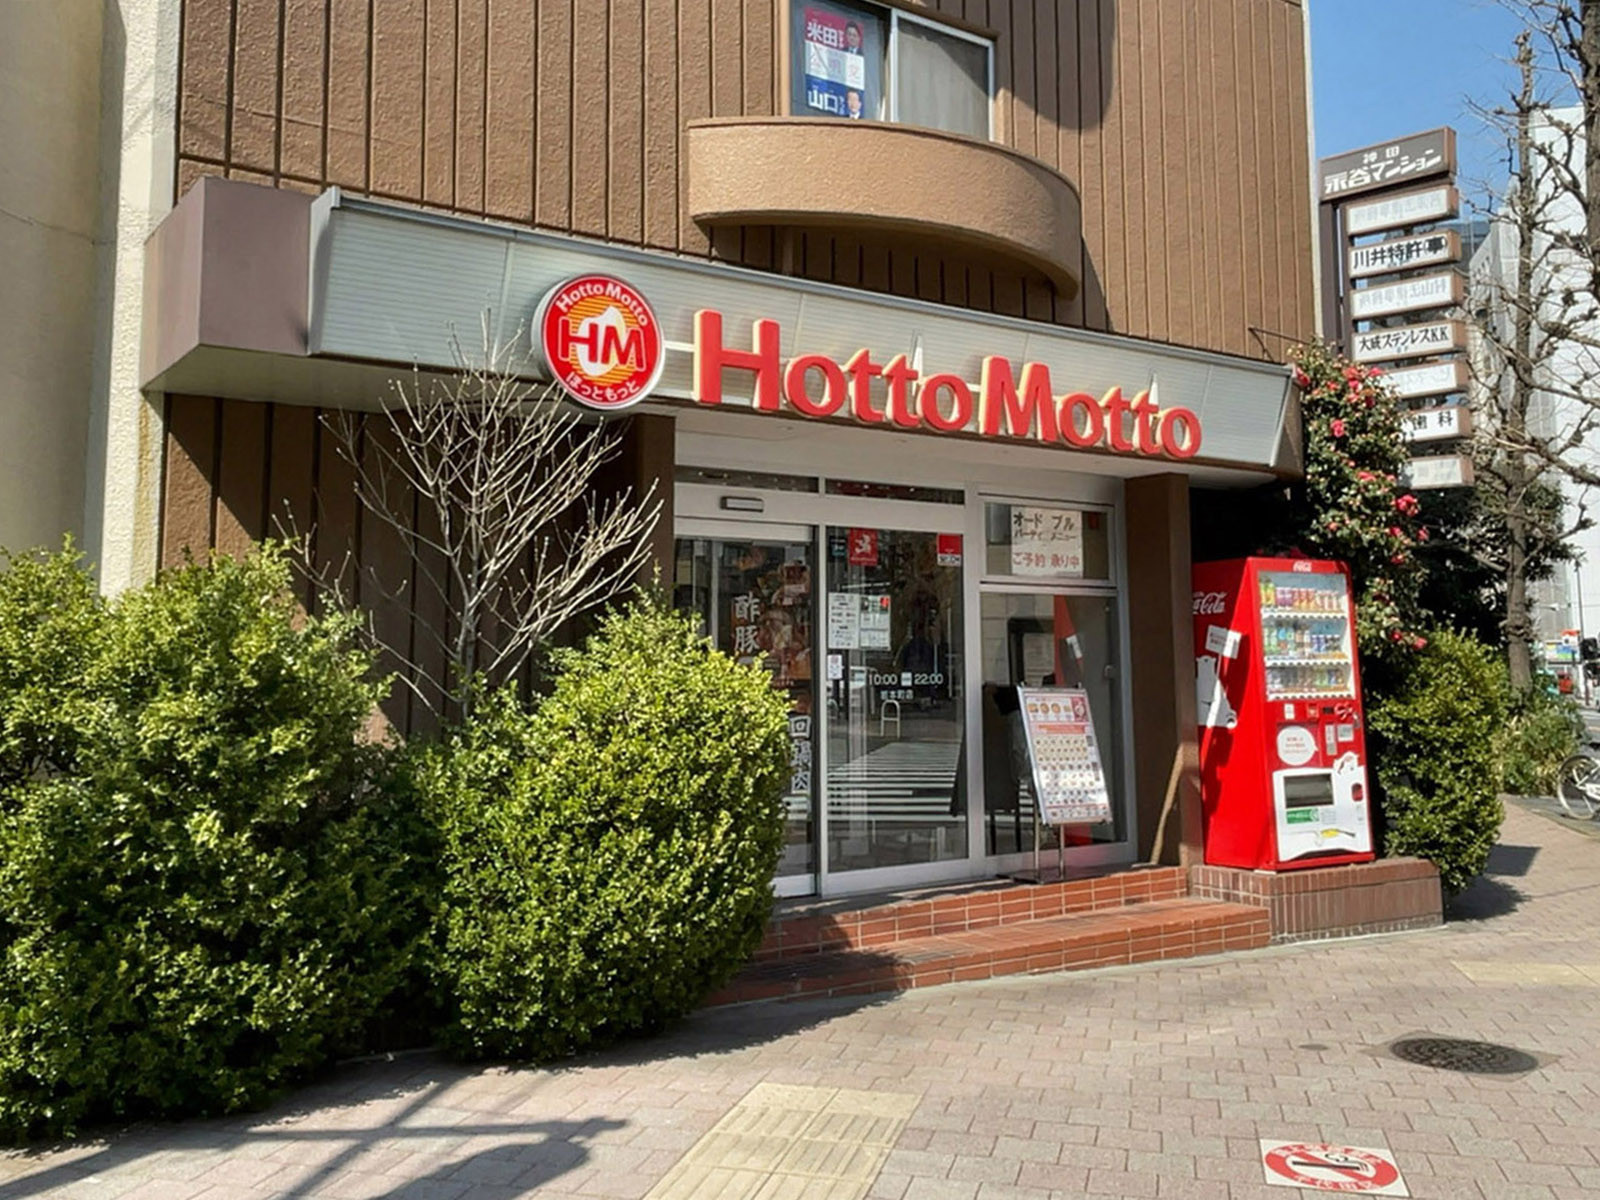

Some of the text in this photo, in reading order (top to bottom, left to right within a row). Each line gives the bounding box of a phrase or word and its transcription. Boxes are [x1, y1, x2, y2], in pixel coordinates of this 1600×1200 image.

[807, 21, 838, 47] 米田
[807, 89, 839, 114] 山口
[555, 282, 648, 326] HottoMotto
[558, 316, 646, 372] HM
[565, 371, 641, 402] ほっともっと
[692, 308, 1203, 460] HottoMotto
[734, 591, 761, 654] 酢豚
[868, 673, 898, 686] 10:00
[914, 673, 944, 685] 22:00
